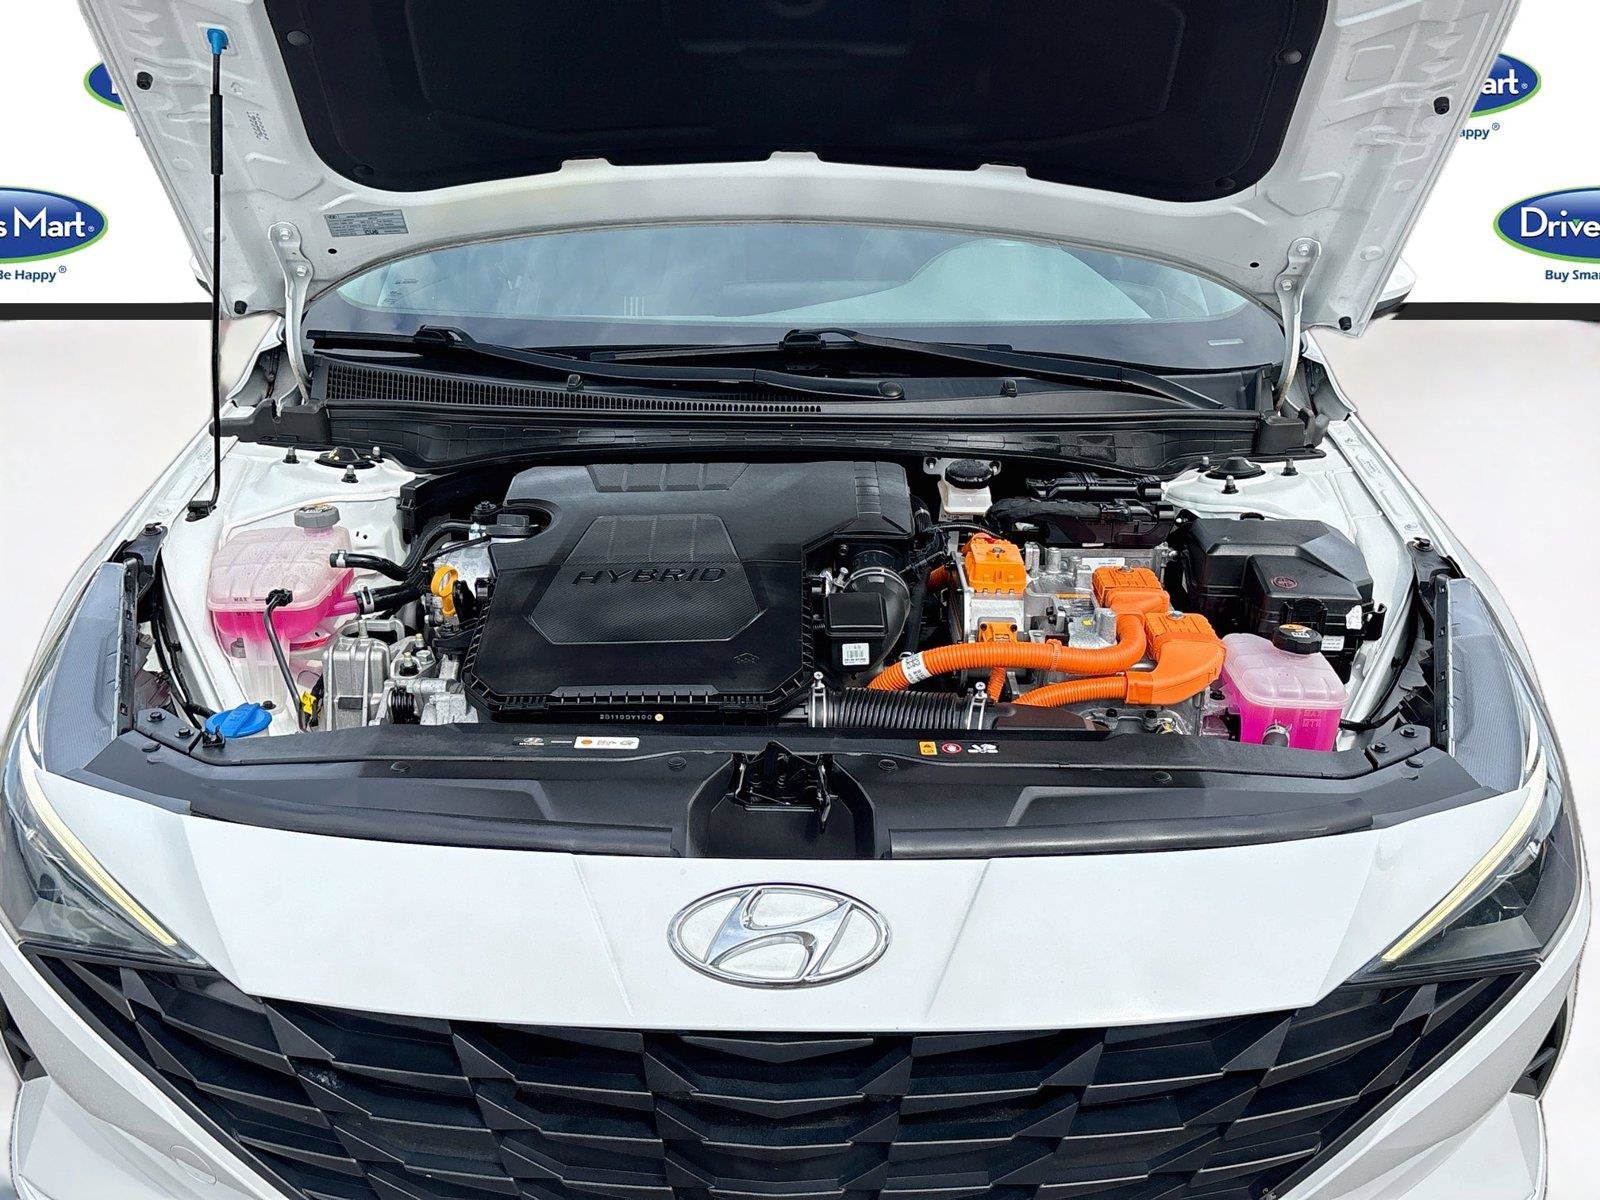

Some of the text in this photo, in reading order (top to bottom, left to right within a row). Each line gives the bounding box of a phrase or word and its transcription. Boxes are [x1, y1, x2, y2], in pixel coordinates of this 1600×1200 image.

[1481, 69, 1519, 94] art
[13, 206, 86, 237] Mart
[15, 270, 56, 283] Happy
[1545, 269, 1570, 283] Buy
[571, 567, 726, 585] HYBRID
